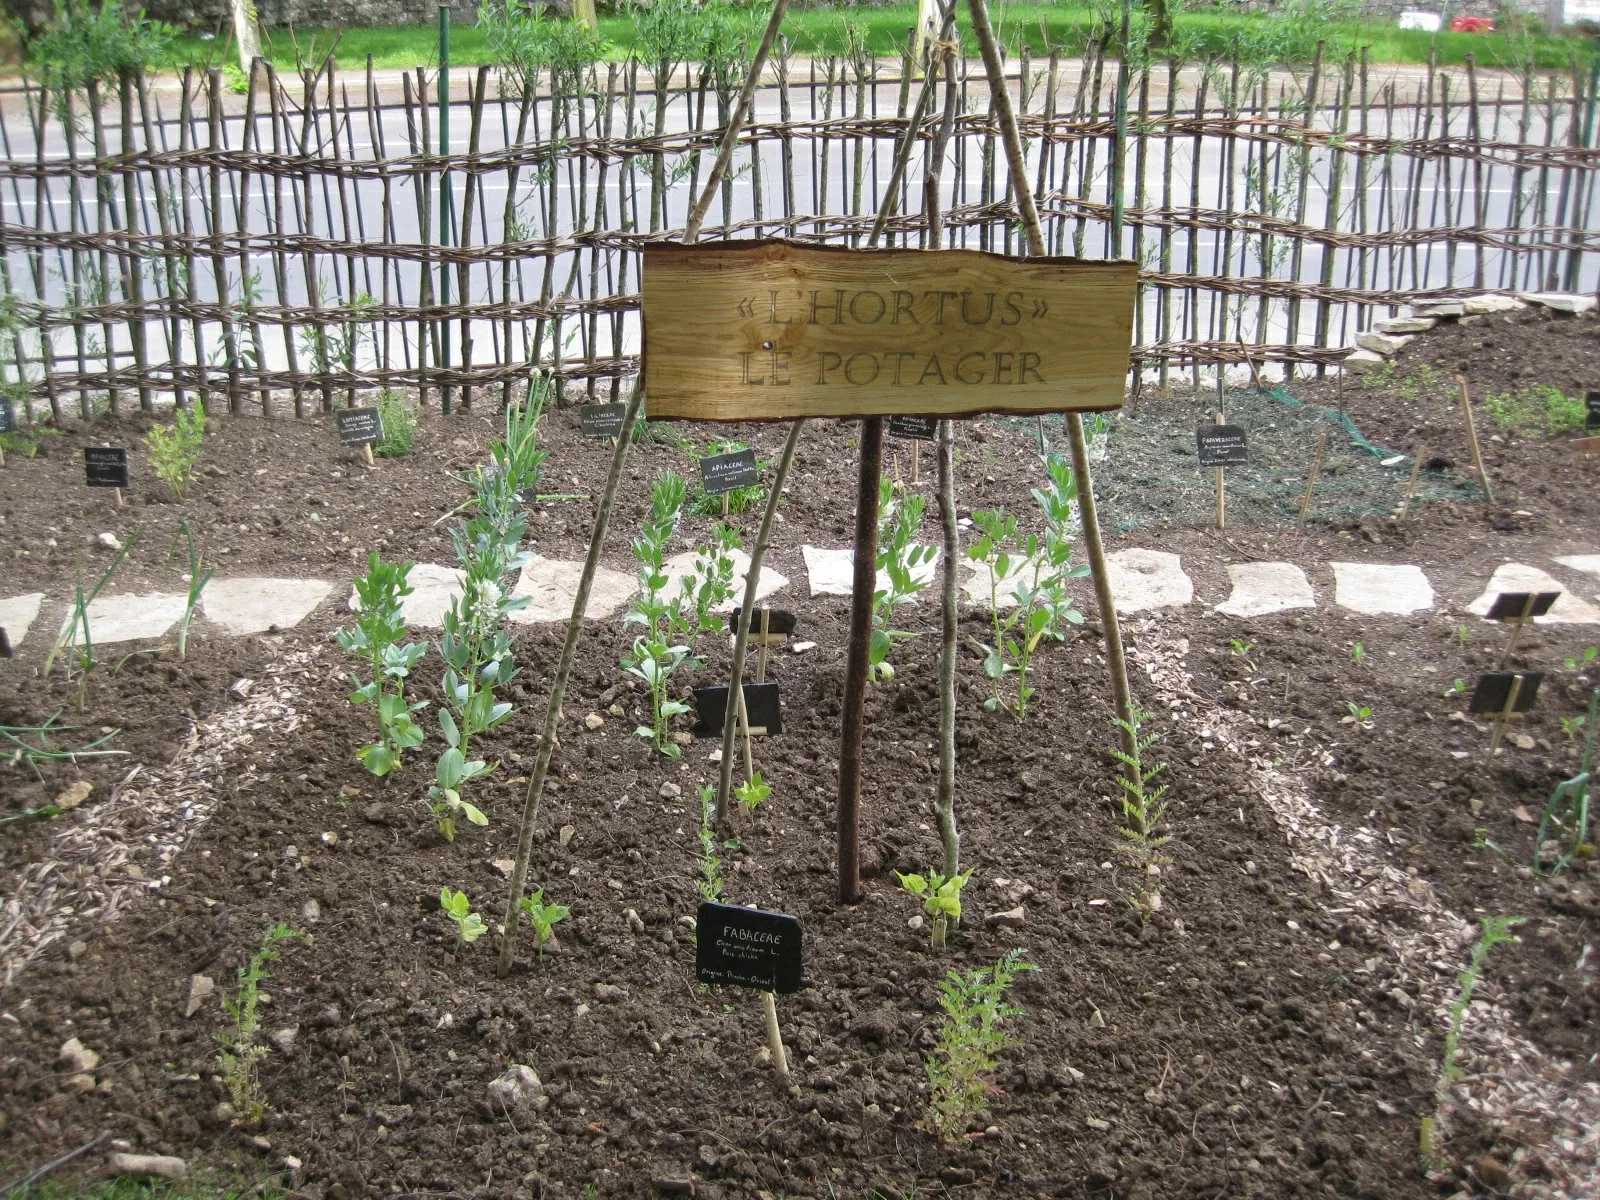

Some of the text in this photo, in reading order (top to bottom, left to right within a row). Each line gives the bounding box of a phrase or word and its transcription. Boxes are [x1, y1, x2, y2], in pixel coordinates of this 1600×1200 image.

[740, 351, 1048, 386] LE POTAGER
[712, 460, 744, 472] APIACEAE
[723, 926, 783, 945] FABACEAE
